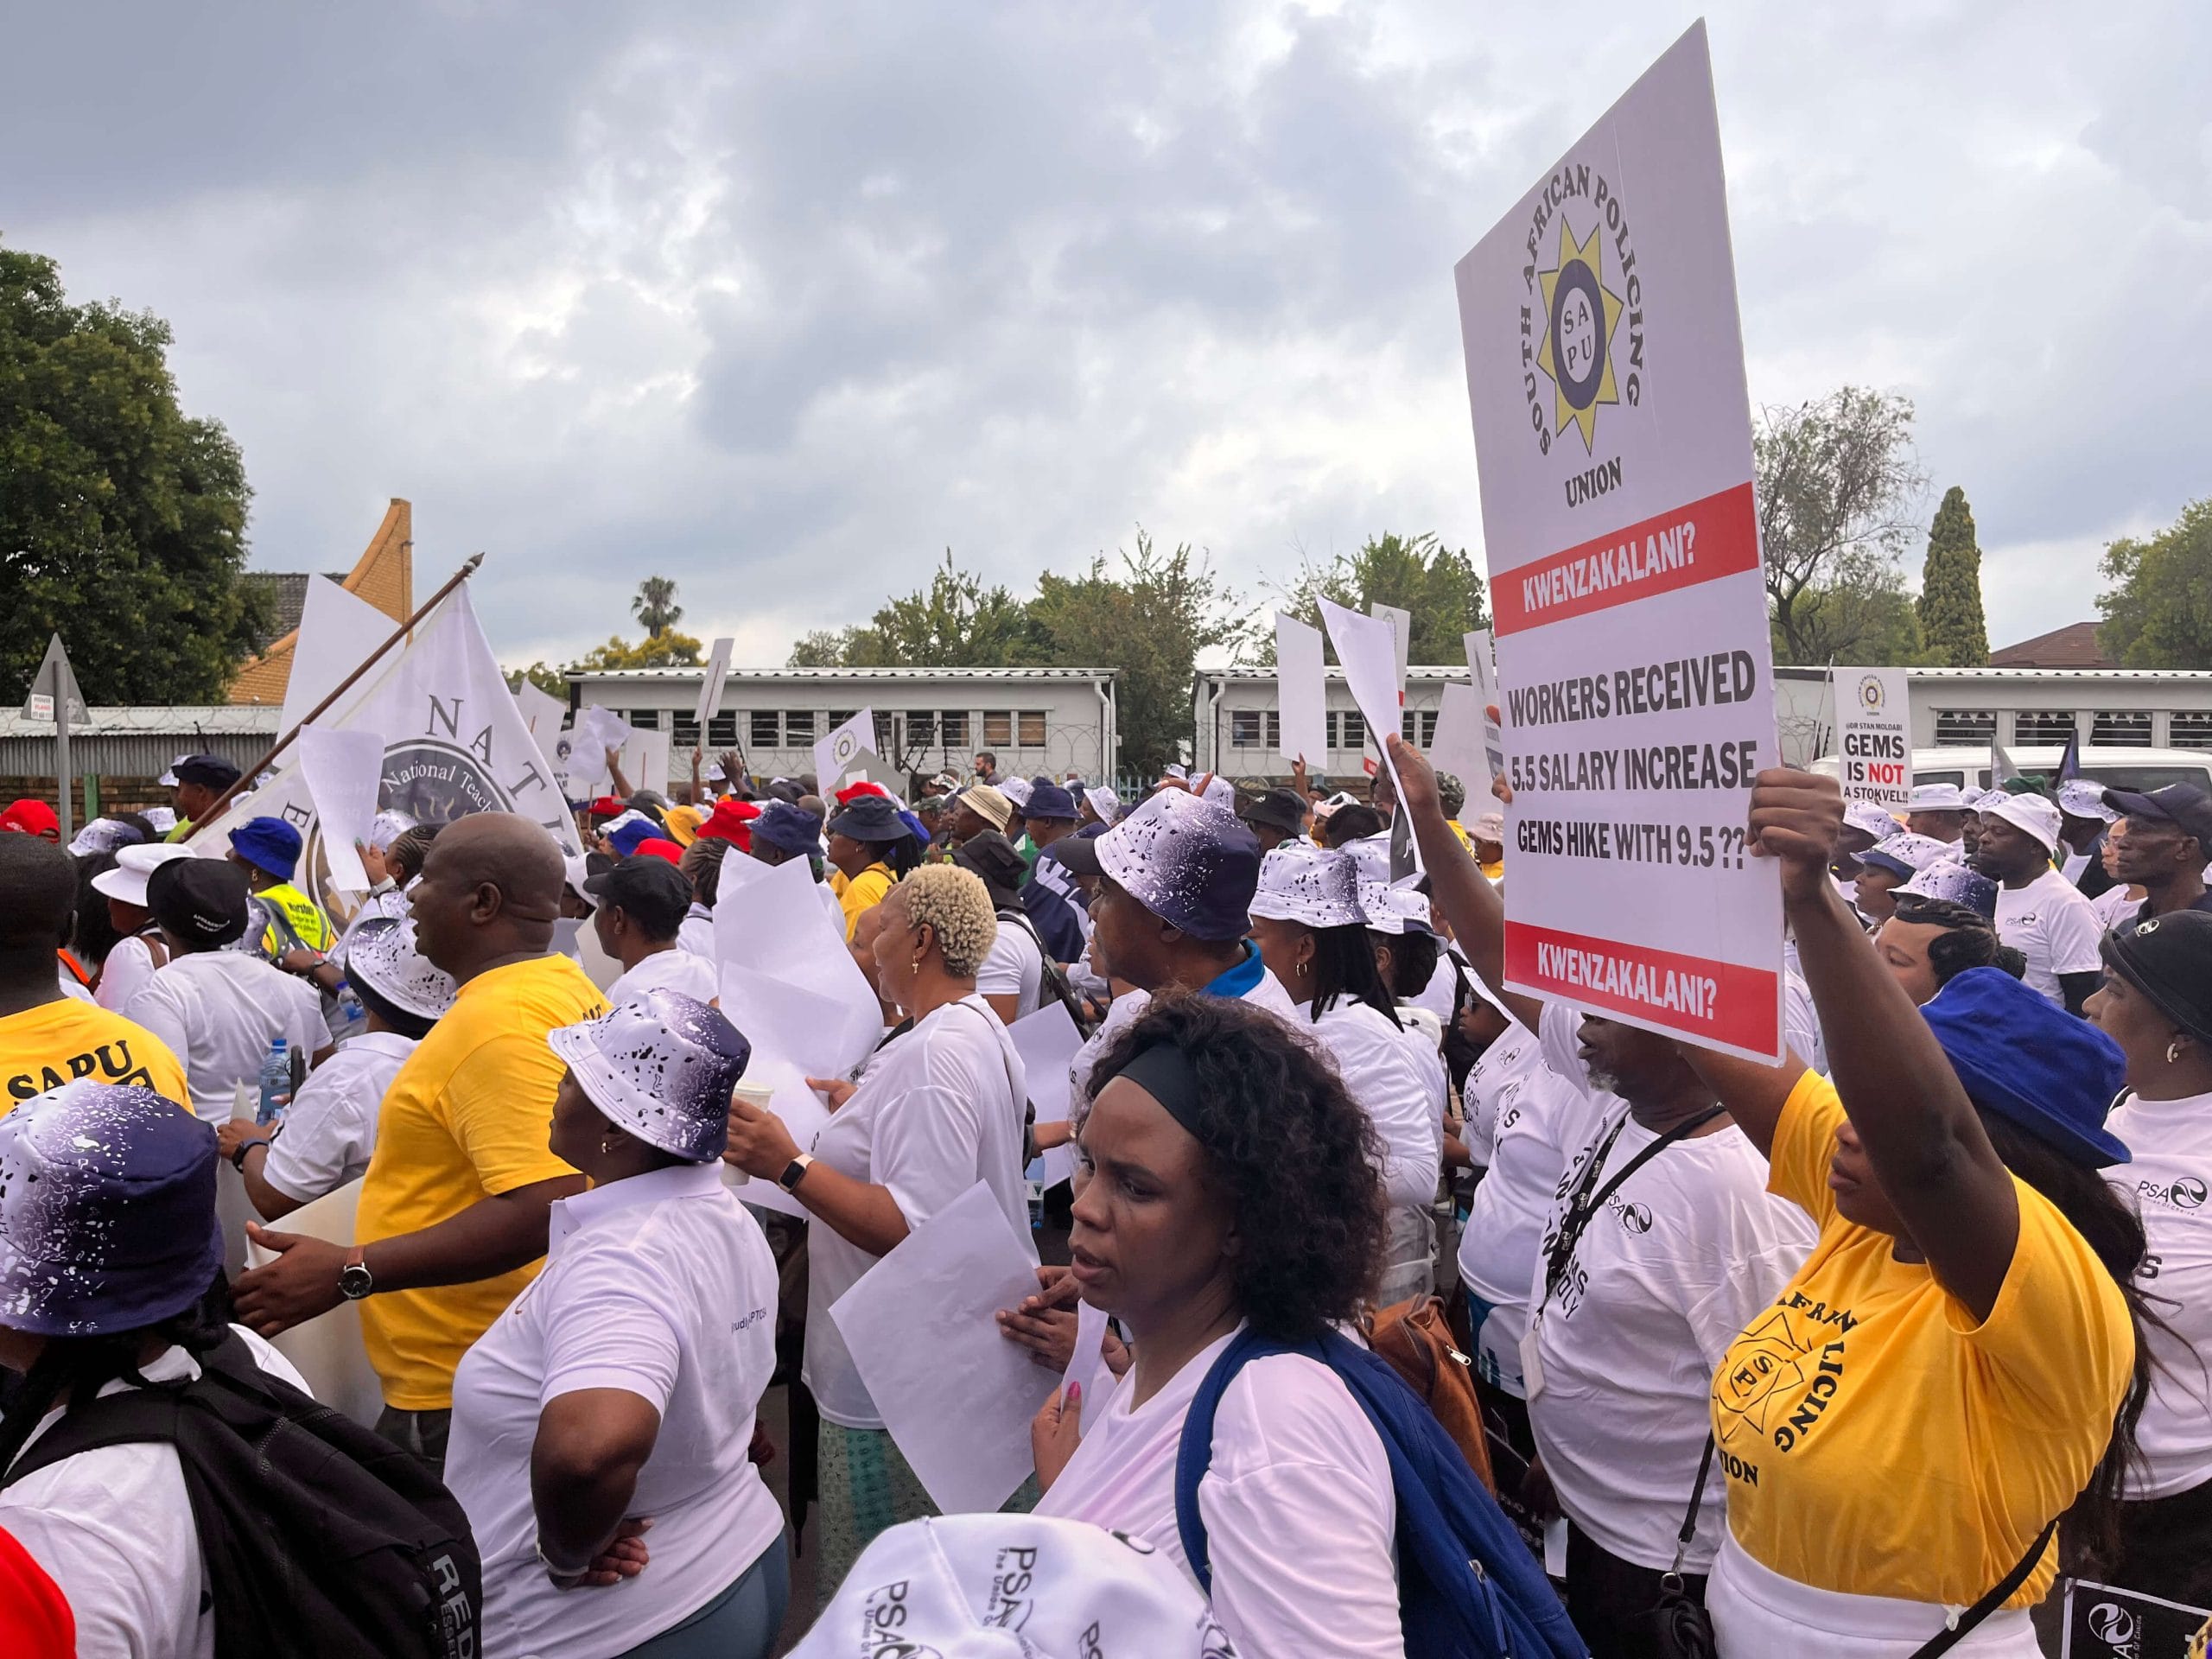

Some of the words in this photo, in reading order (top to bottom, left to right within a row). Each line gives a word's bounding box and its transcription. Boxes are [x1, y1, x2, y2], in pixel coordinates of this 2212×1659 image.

[1522, 163, 1591, 296] AFRICAN
[1593, 175, 1643, 408] POLICING
[1521, 304, 1551, 457] SOUTH
[1565, 455, 1622, 508] UNION
[1522, 521, 1696, 613] KWENZAKALANI?
[1508, 673, 1611, 728] WORKERS
[1614, 650, 1756, 716] RECEIVED
[1845, 733, 1905, 760] GEMS
[1859, 722, 1875, 731] STAN
[378, 760, 457, 795] National
[1512, 755, 1536, 792] 5.5
[1539, 749, 1619, 791] SALARY
[1624, 740, 1758, 790] INCREASE
[1847, 761, 1865, 782] IS
[1868, 762, 1904, 785] NOT
[1844, 786, 1852, 798] A
[1853, 787, 1909, 804] STOKVEL!!
[1517, 819, 1563, 855] GEMS
[1566, 821, 1611, 859] HIKE
[1613, 823, 1672, 864] WITH
[1537, 941, 1717, 1020] KWENZAKALANI?
[7, 1039, 133, 1099] SAPU
[2137, 1179, 2169, 1202] PSA
[871, 1580, 909, 1646] PSA
[994, 1545, 1038, 1628] PSA
